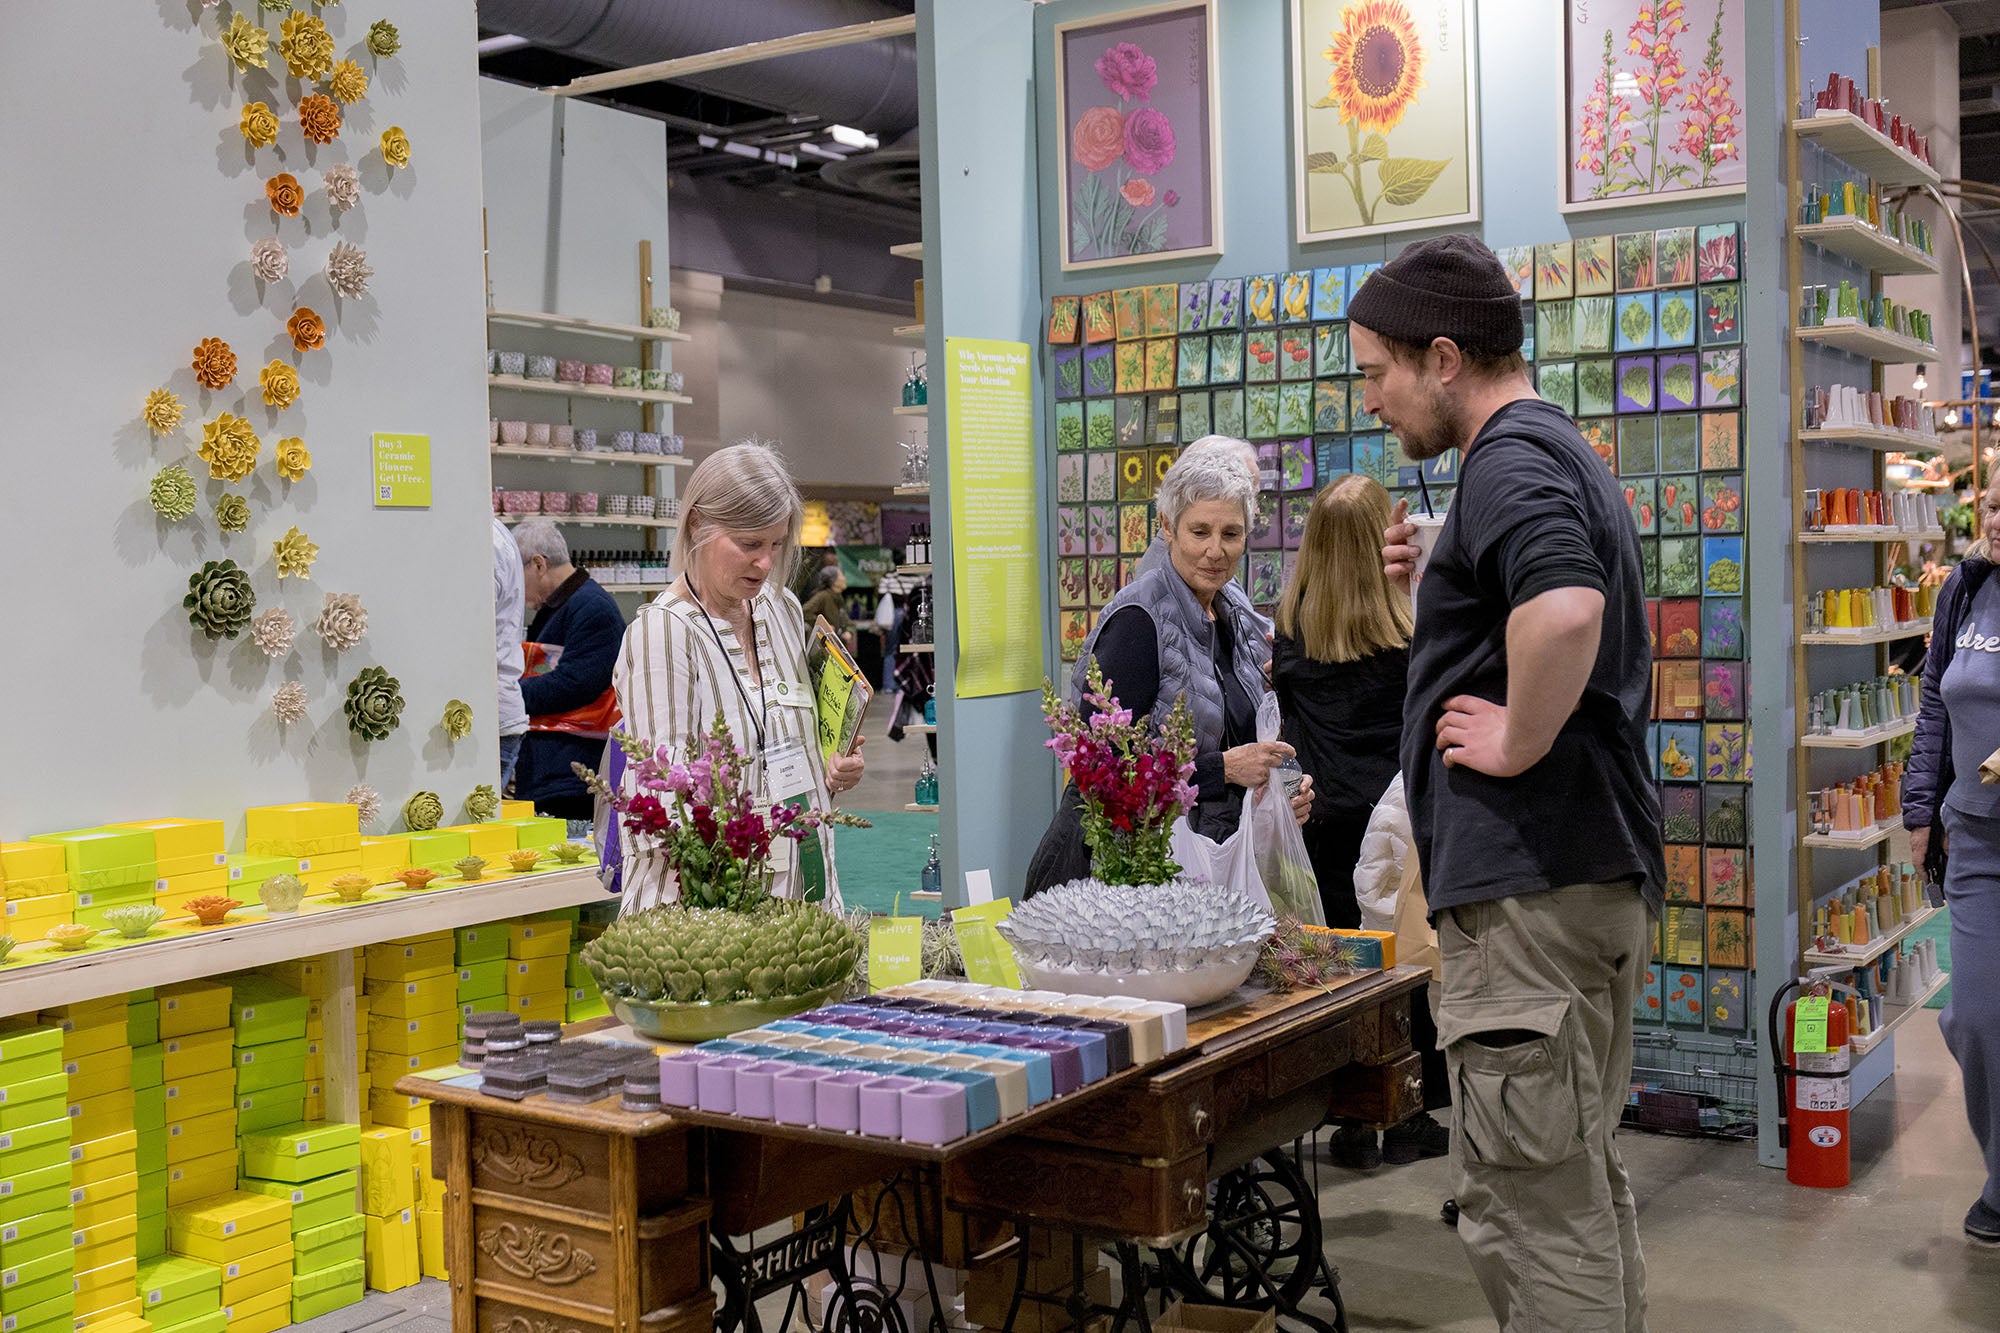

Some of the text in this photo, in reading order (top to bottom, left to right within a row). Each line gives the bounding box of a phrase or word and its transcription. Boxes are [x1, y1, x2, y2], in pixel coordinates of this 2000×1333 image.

[959, 350, 975, 362] Why
[959, 362, 1016, 375] Seeds Are Worth
[959, 374, 977, 384] Your
[379, 440, 403, 451] Buy 3
[379, 450, 415, 461] Ceramic
[1318, 442, 1330, 477] Mint
[1386, 442, 1399, 478] Leek
[379, 462, 414, 472] Flowers
[379, 473, 395, 483] Get
[878, 925, 913, 935] CHIVE
